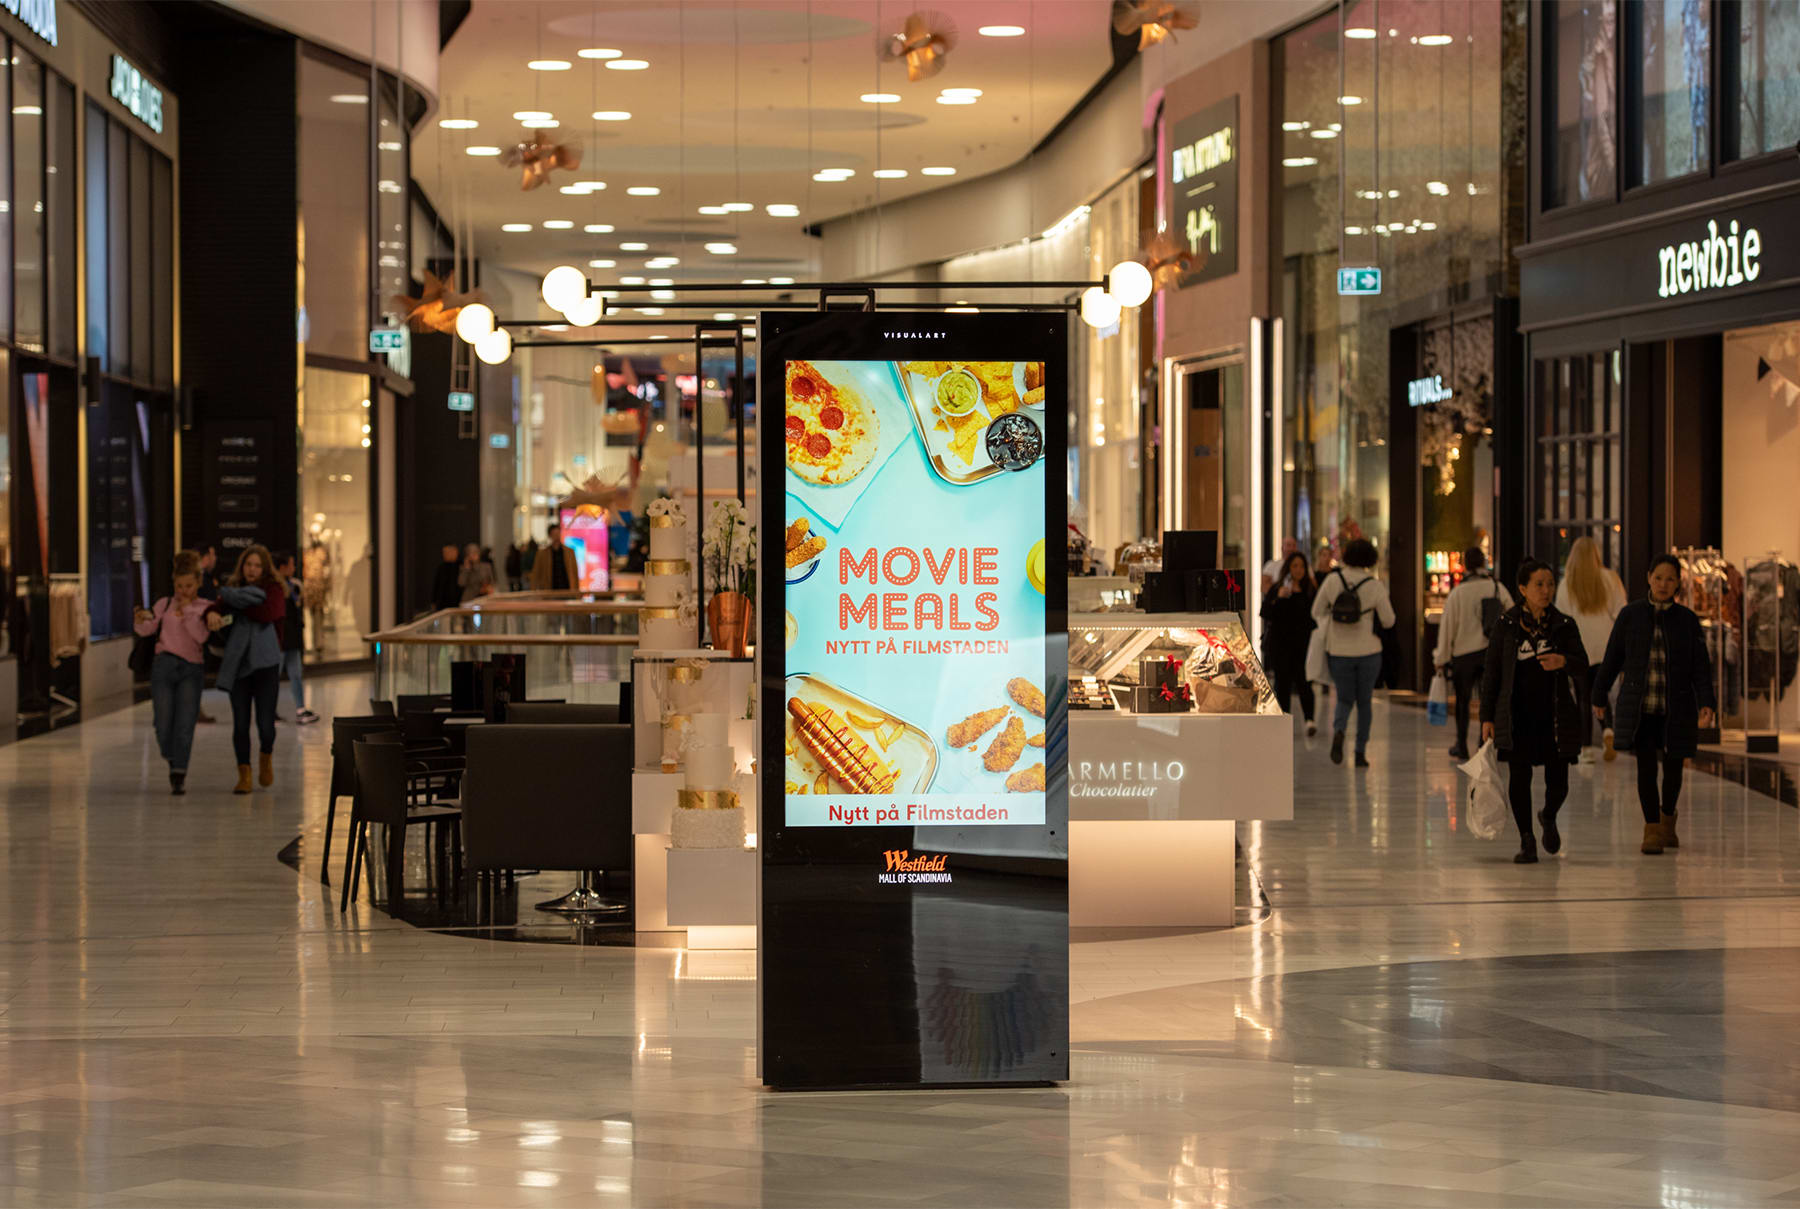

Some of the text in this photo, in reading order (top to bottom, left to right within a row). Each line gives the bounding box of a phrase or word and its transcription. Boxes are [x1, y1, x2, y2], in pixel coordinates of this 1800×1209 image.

[1658, 219, 1761, 298] newbie
[839, 547, 999, 586] MOVIE
[839, 592, 1000, 631] MEALS
[826, 637, 1009, 654] NYTT PÅ FILMSTADEN
[1070, 783, 1157, 797] Chocolatier
[829, 803, 1009, 824] Nytt på Filmstaden
[883, 850, 949, 872] Westfield
[879, 873, 952, 883] MALL OF SCANDINAVIA
